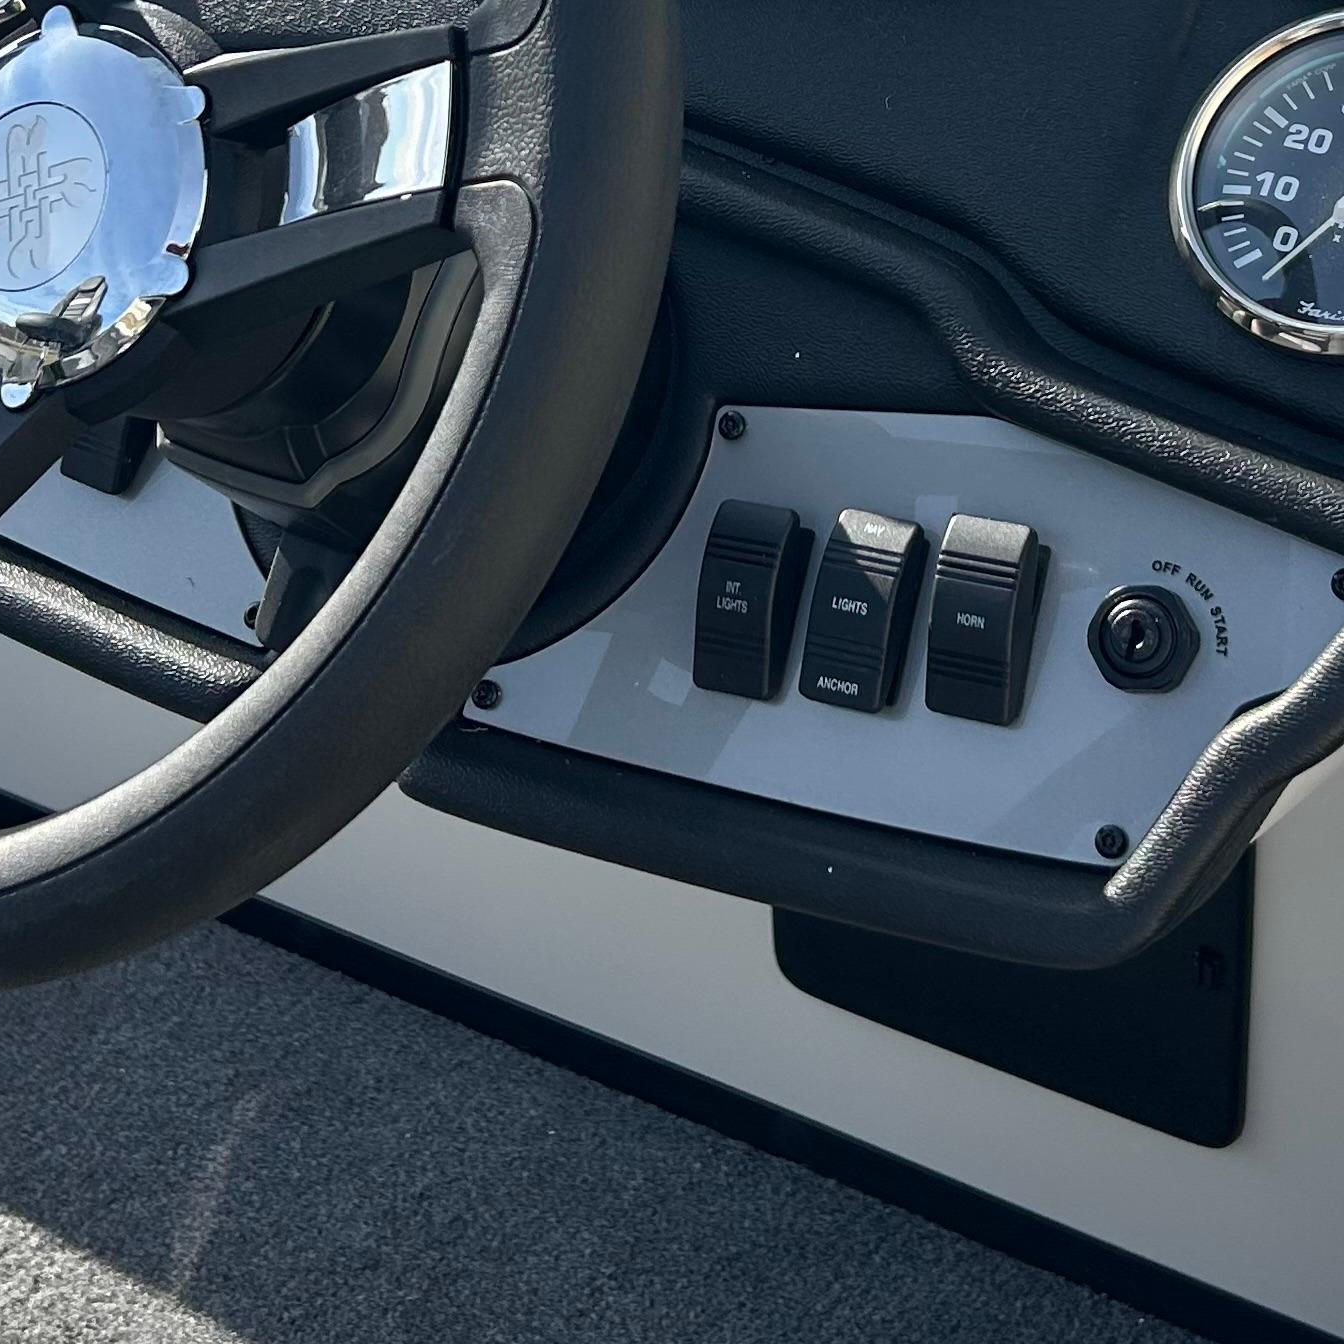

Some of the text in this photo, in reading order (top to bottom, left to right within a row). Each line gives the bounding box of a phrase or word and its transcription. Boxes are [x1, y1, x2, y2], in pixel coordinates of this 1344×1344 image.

[1283, 123, 1333, 154] 20
[1256, 171, 1300, 202] 10
[1272, 225, 1299, 253] 0
[863, 522, 886, 537] NAV
[716, 596, 748, 614] LIGHTS
[831, 596, 869, 616] LIGHTS
[1151, 560, 1228, 657] OFF RUN START
[956, 612, 986, 630] HORN
[816, 675, 859, 696] ANCHOR
